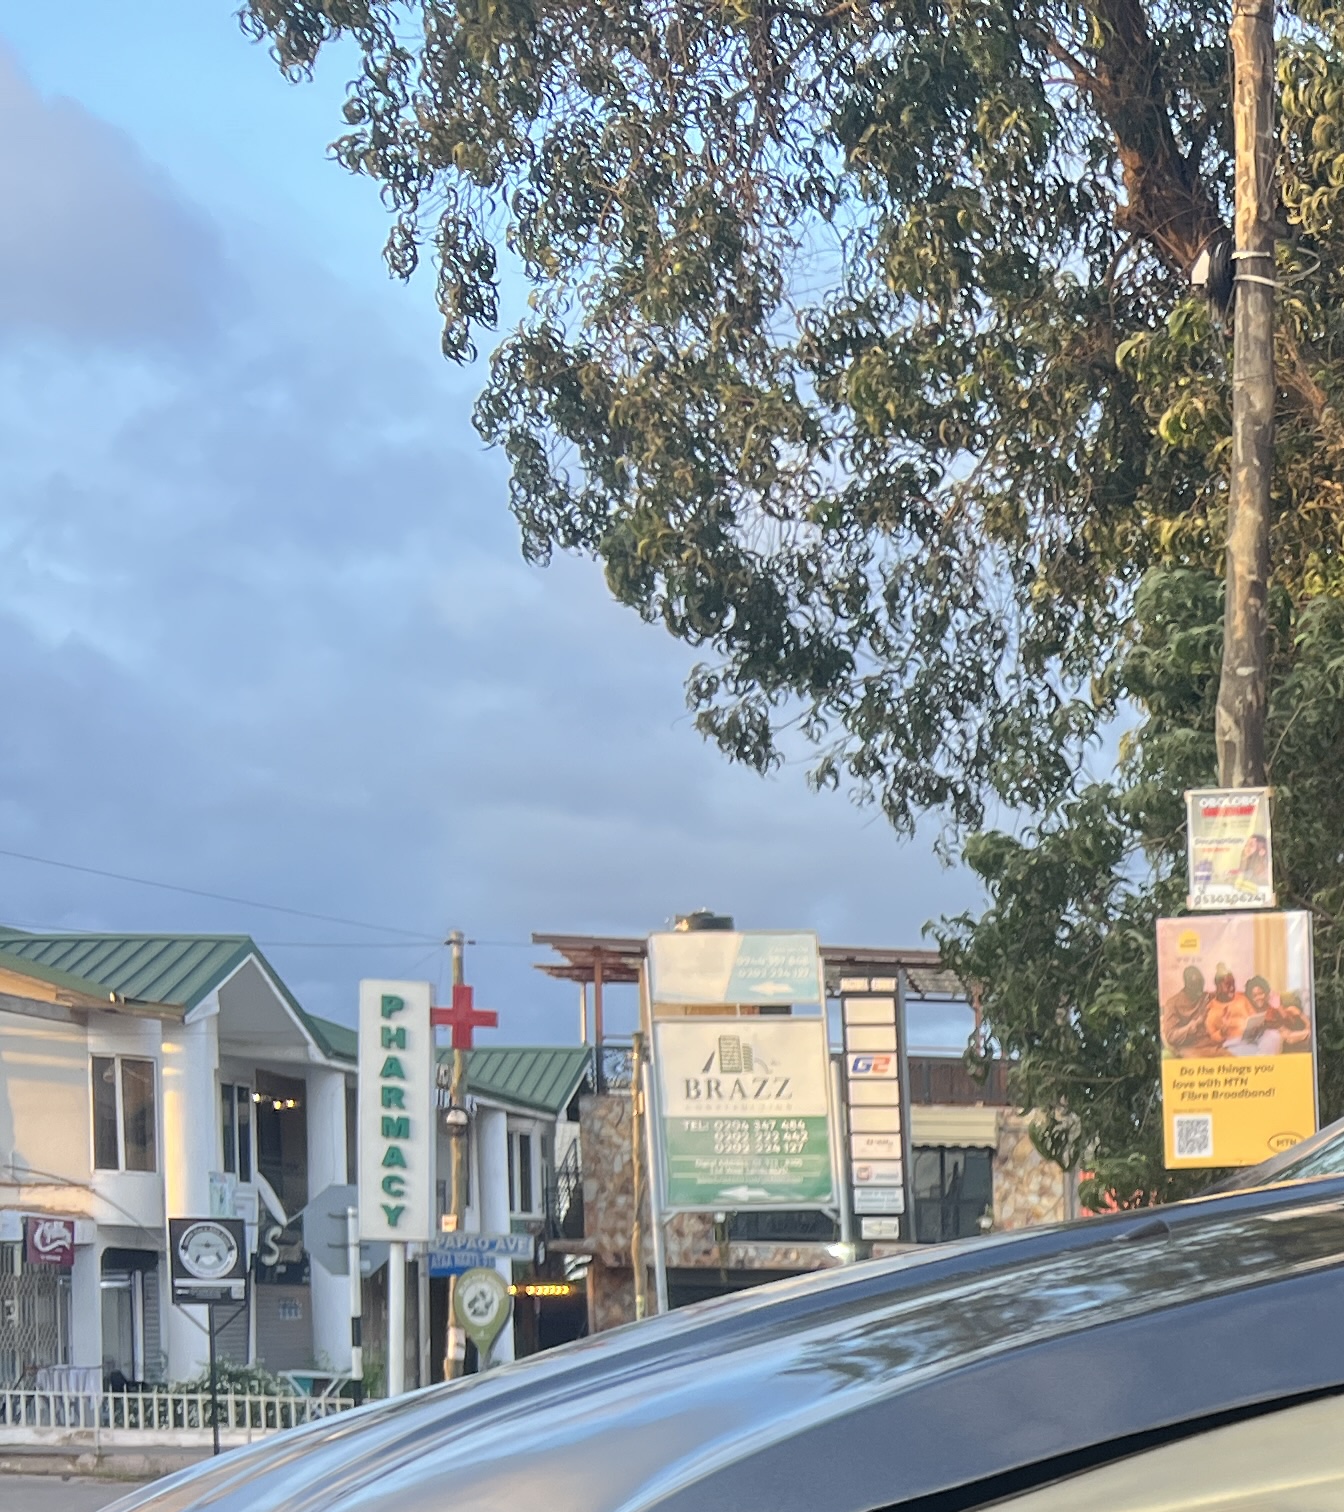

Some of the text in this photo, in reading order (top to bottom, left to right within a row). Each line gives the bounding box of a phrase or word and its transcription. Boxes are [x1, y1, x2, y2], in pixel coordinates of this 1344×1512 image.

[1180, 1064, 1275, 1076] Do the things you
[685, 1077, 793, 1101] BRAZZ
[1172, 1077, 1248, 1089] love with MTN
[1181, 1088, 1275, 1101] Fibre Broadband!
[380, 994, 410, 1227] PHARMACY
[1276, 1138, 1297, 1147] MTN
[495, 1236, 529, 1253] AVE
